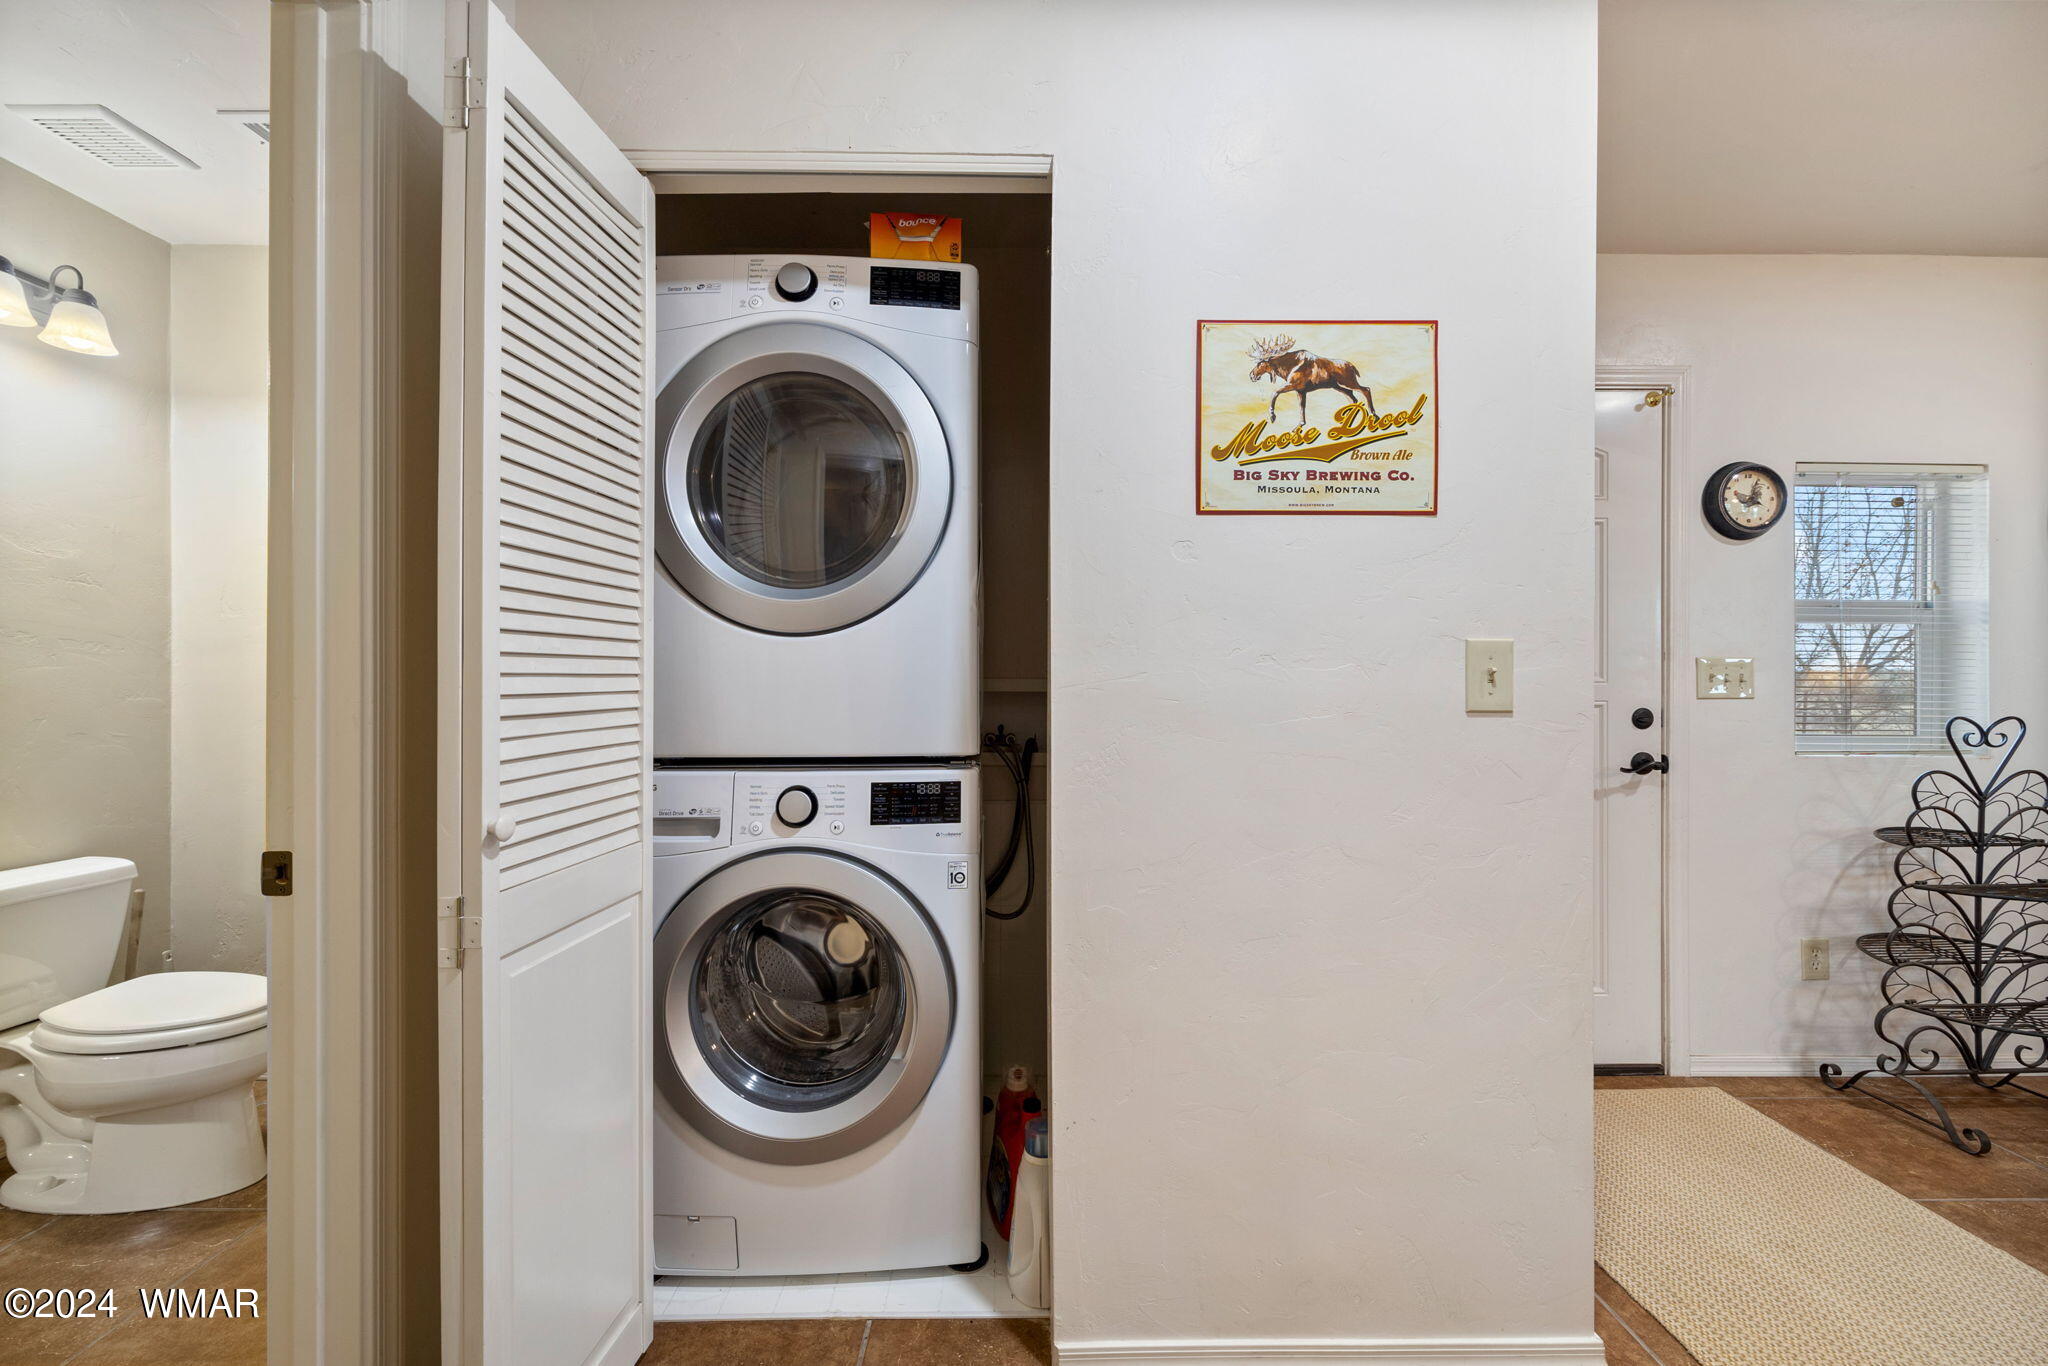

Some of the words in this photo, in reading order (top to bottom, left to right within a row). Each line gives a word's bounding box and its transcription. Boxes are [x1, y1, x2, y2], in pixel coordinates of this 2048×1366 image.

[898, 217, 937, 228] bounce
[1210, 419, 1320, 461] Moose
[1327, 393, 1428, 440] Drool
[1350, 449, 1391, 461] Brown
[1391, 449, 1413, 461] Ale
[1233, 470, 1262, 481] BIG
[1268, 470, 1300, 481] SKY
[1306, 470, 1382, 481] BREWING
[1325, 485, 1381, 494] MONTANA
